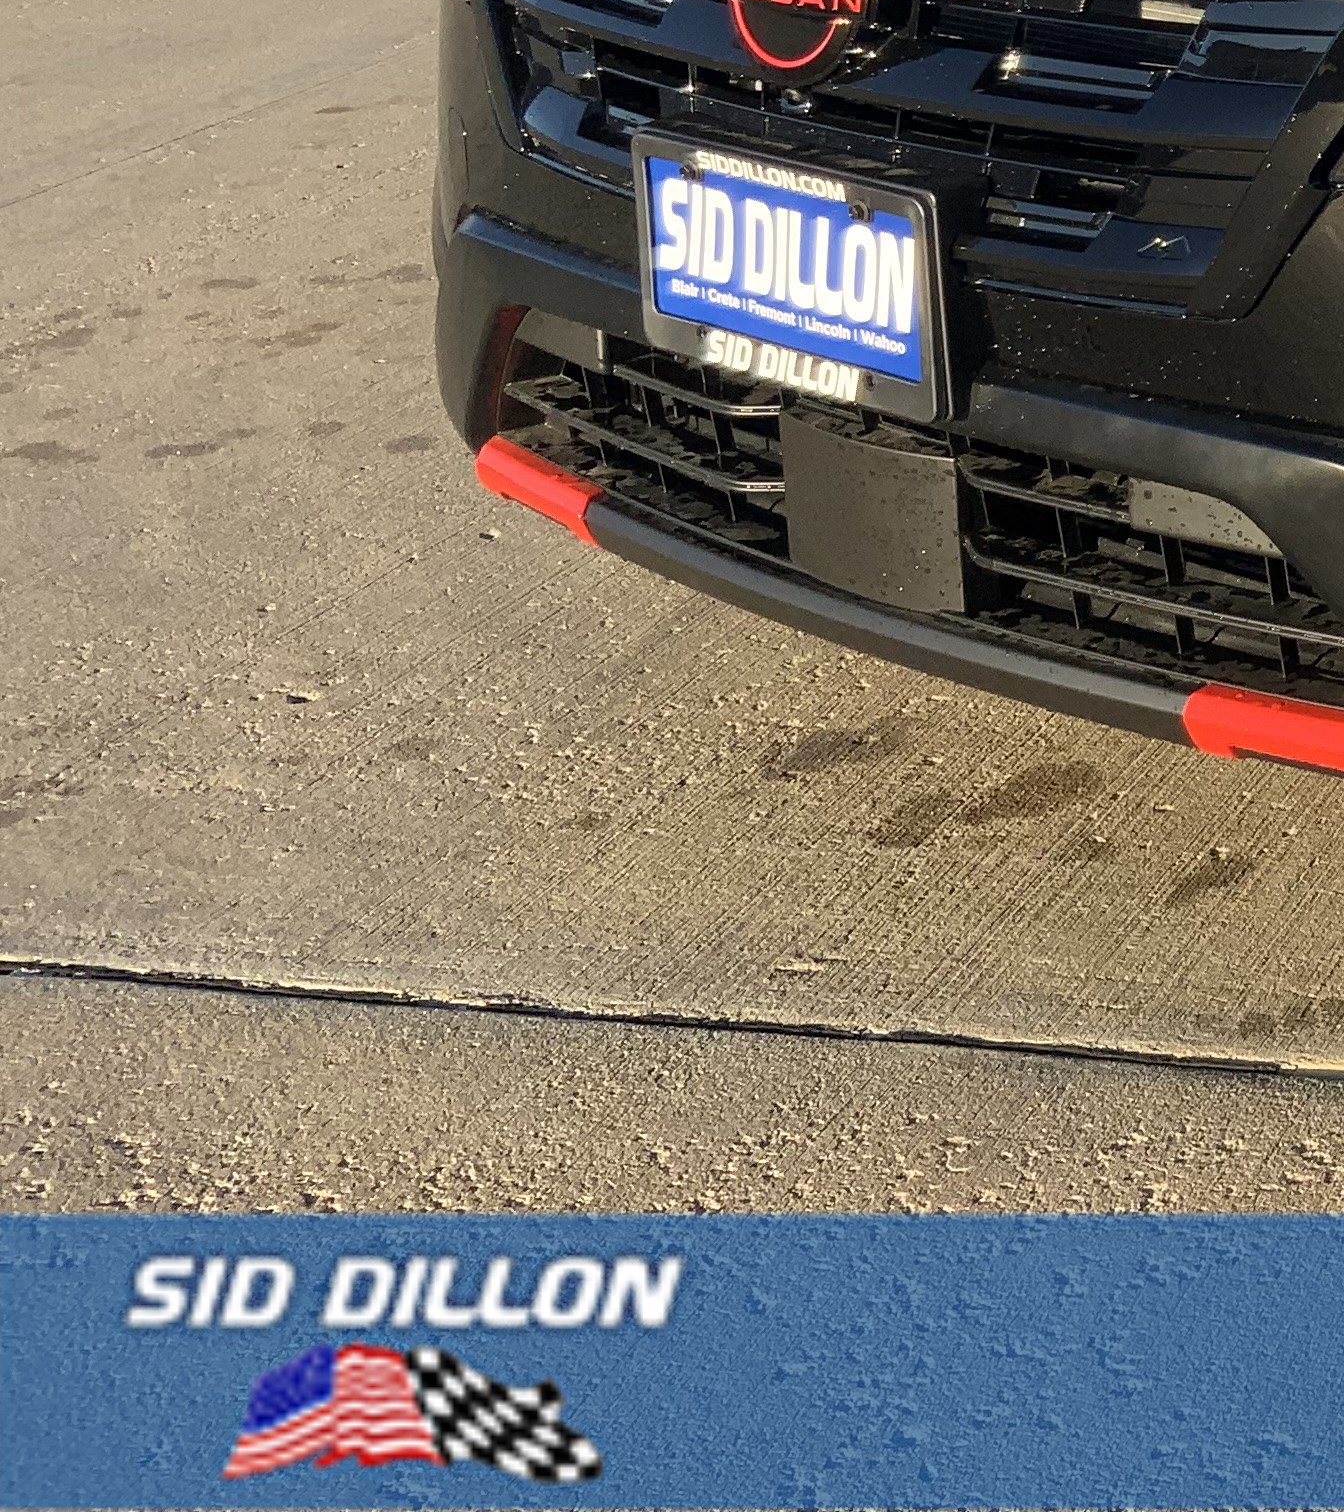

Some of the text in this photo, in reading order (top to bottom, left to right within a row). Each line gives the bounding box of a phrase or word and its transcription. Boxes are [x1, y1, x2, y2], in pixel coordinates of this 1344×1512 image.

[695, 150, 846, 203] SIDDILLON.COM
[656, 177, 916, 335] SID DILLON
[671, 279, 907, 356] Blair Crete Fremont Lincoln Wahoo
[705, 329, 861, 403] SID DILLON
